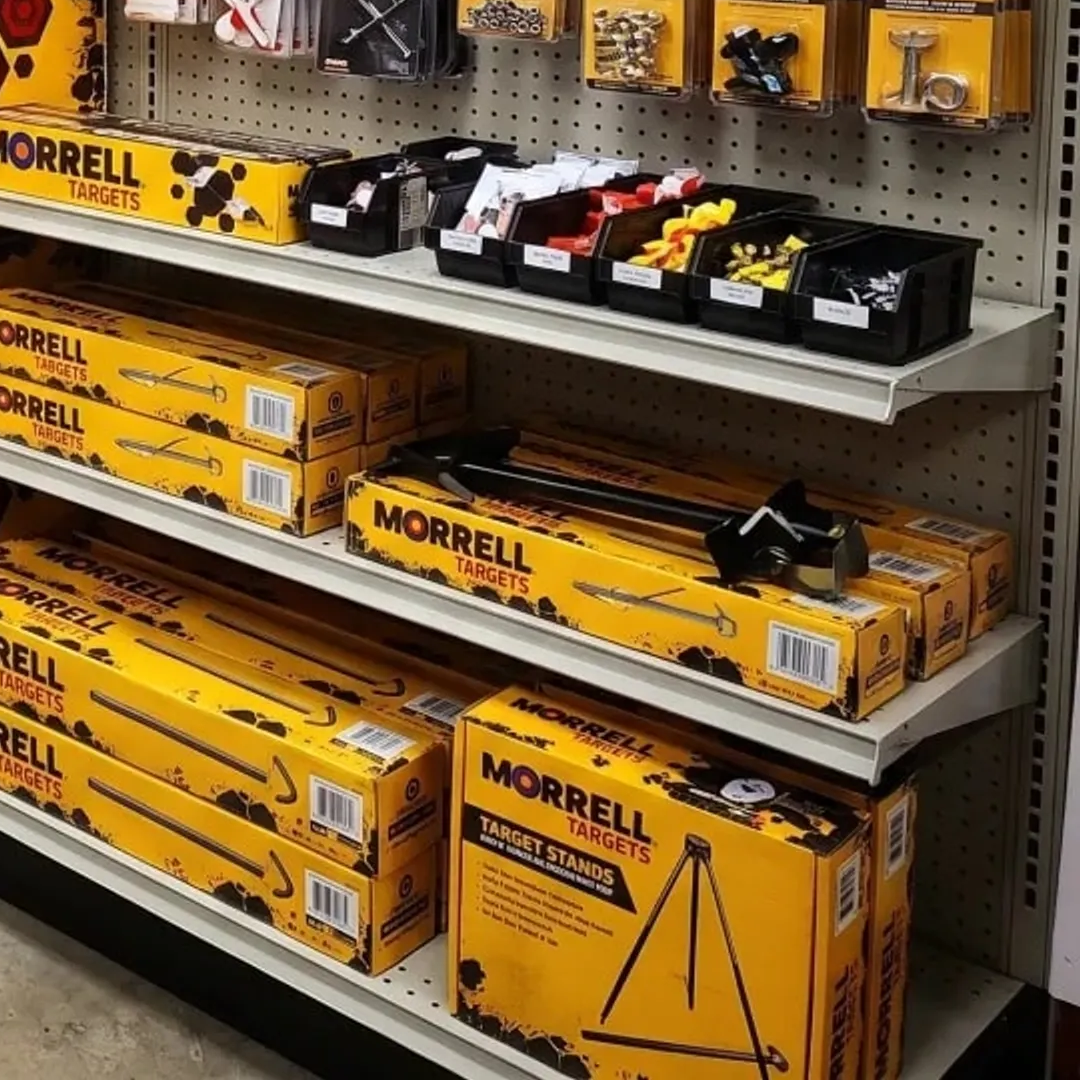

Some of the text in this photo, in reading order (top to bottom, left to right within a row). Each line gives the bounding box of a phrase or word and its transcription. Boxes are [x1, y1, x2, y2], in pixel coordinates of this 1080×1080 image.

[68, 179, 141, 212] TARGETS
[34, 355, 88, 382] TARGETS
[32, 422, 83, 451] TARGETS
[372, 499, 533, 575] MORRELL
[35, 546, 184, 609] MORRELL
[454, 555, 532, 594] TARGETS
[509, 697, 655, 758] MORRELL
[481, 751, 652, 845] MORRELL
[480, 816, 544, 856] TARGET
[546, 845, 615, 886] STANDS
[566, 816, 652, 865] TARGETS
